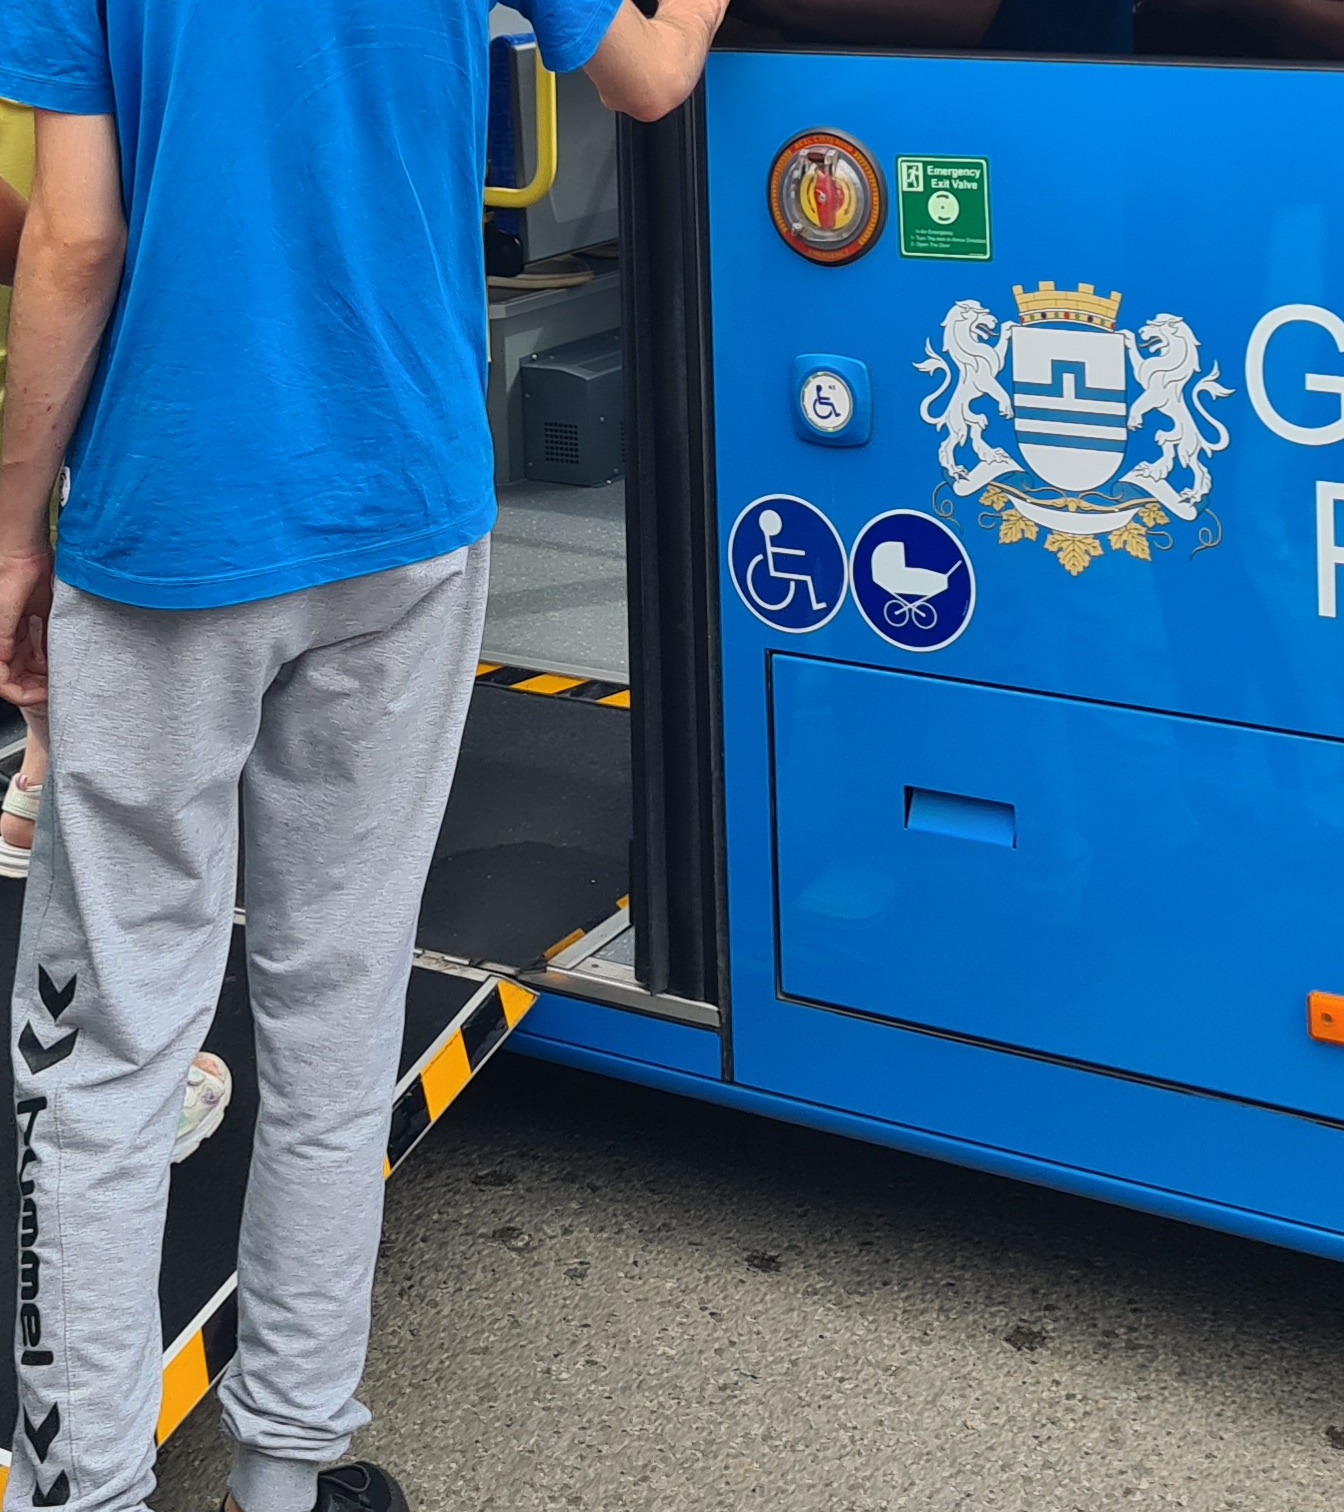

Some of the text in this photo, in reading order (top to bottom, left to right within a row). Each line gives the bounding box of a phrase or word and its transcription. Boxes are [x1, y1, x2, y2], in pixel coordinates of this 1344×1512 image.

[927, 165, 981, 179] Emergency
[931, 178, 978, 190] Exit Valve
